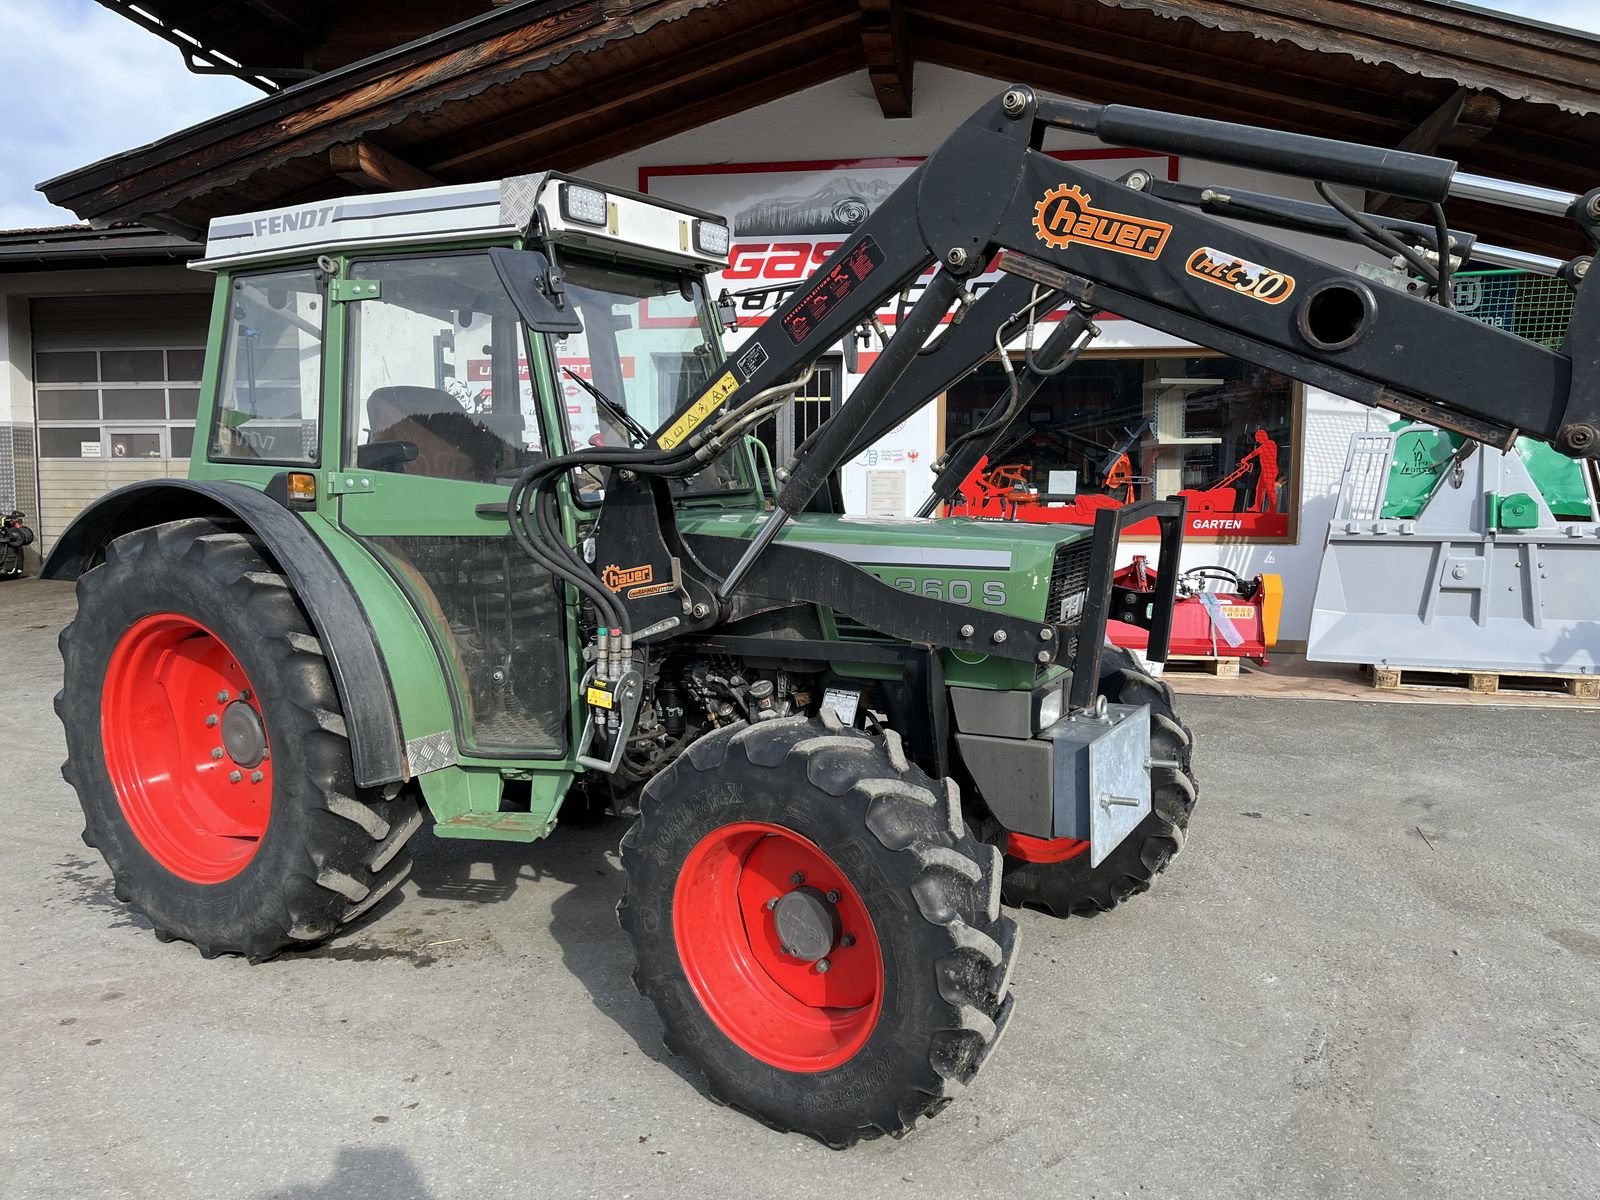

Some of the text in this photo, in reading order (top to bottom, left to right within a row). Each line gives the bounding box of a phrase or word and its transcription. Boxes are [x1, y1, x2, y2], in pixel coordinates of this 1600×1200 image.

[254, 206, 334, 237] FENDT
[1049, 199, 1162, 250] hauer
[1192, 519, 1242, 529] GARTEN
[609, 568, 649, 586] hauer
[894, 577, 1007, 606] 260 S
